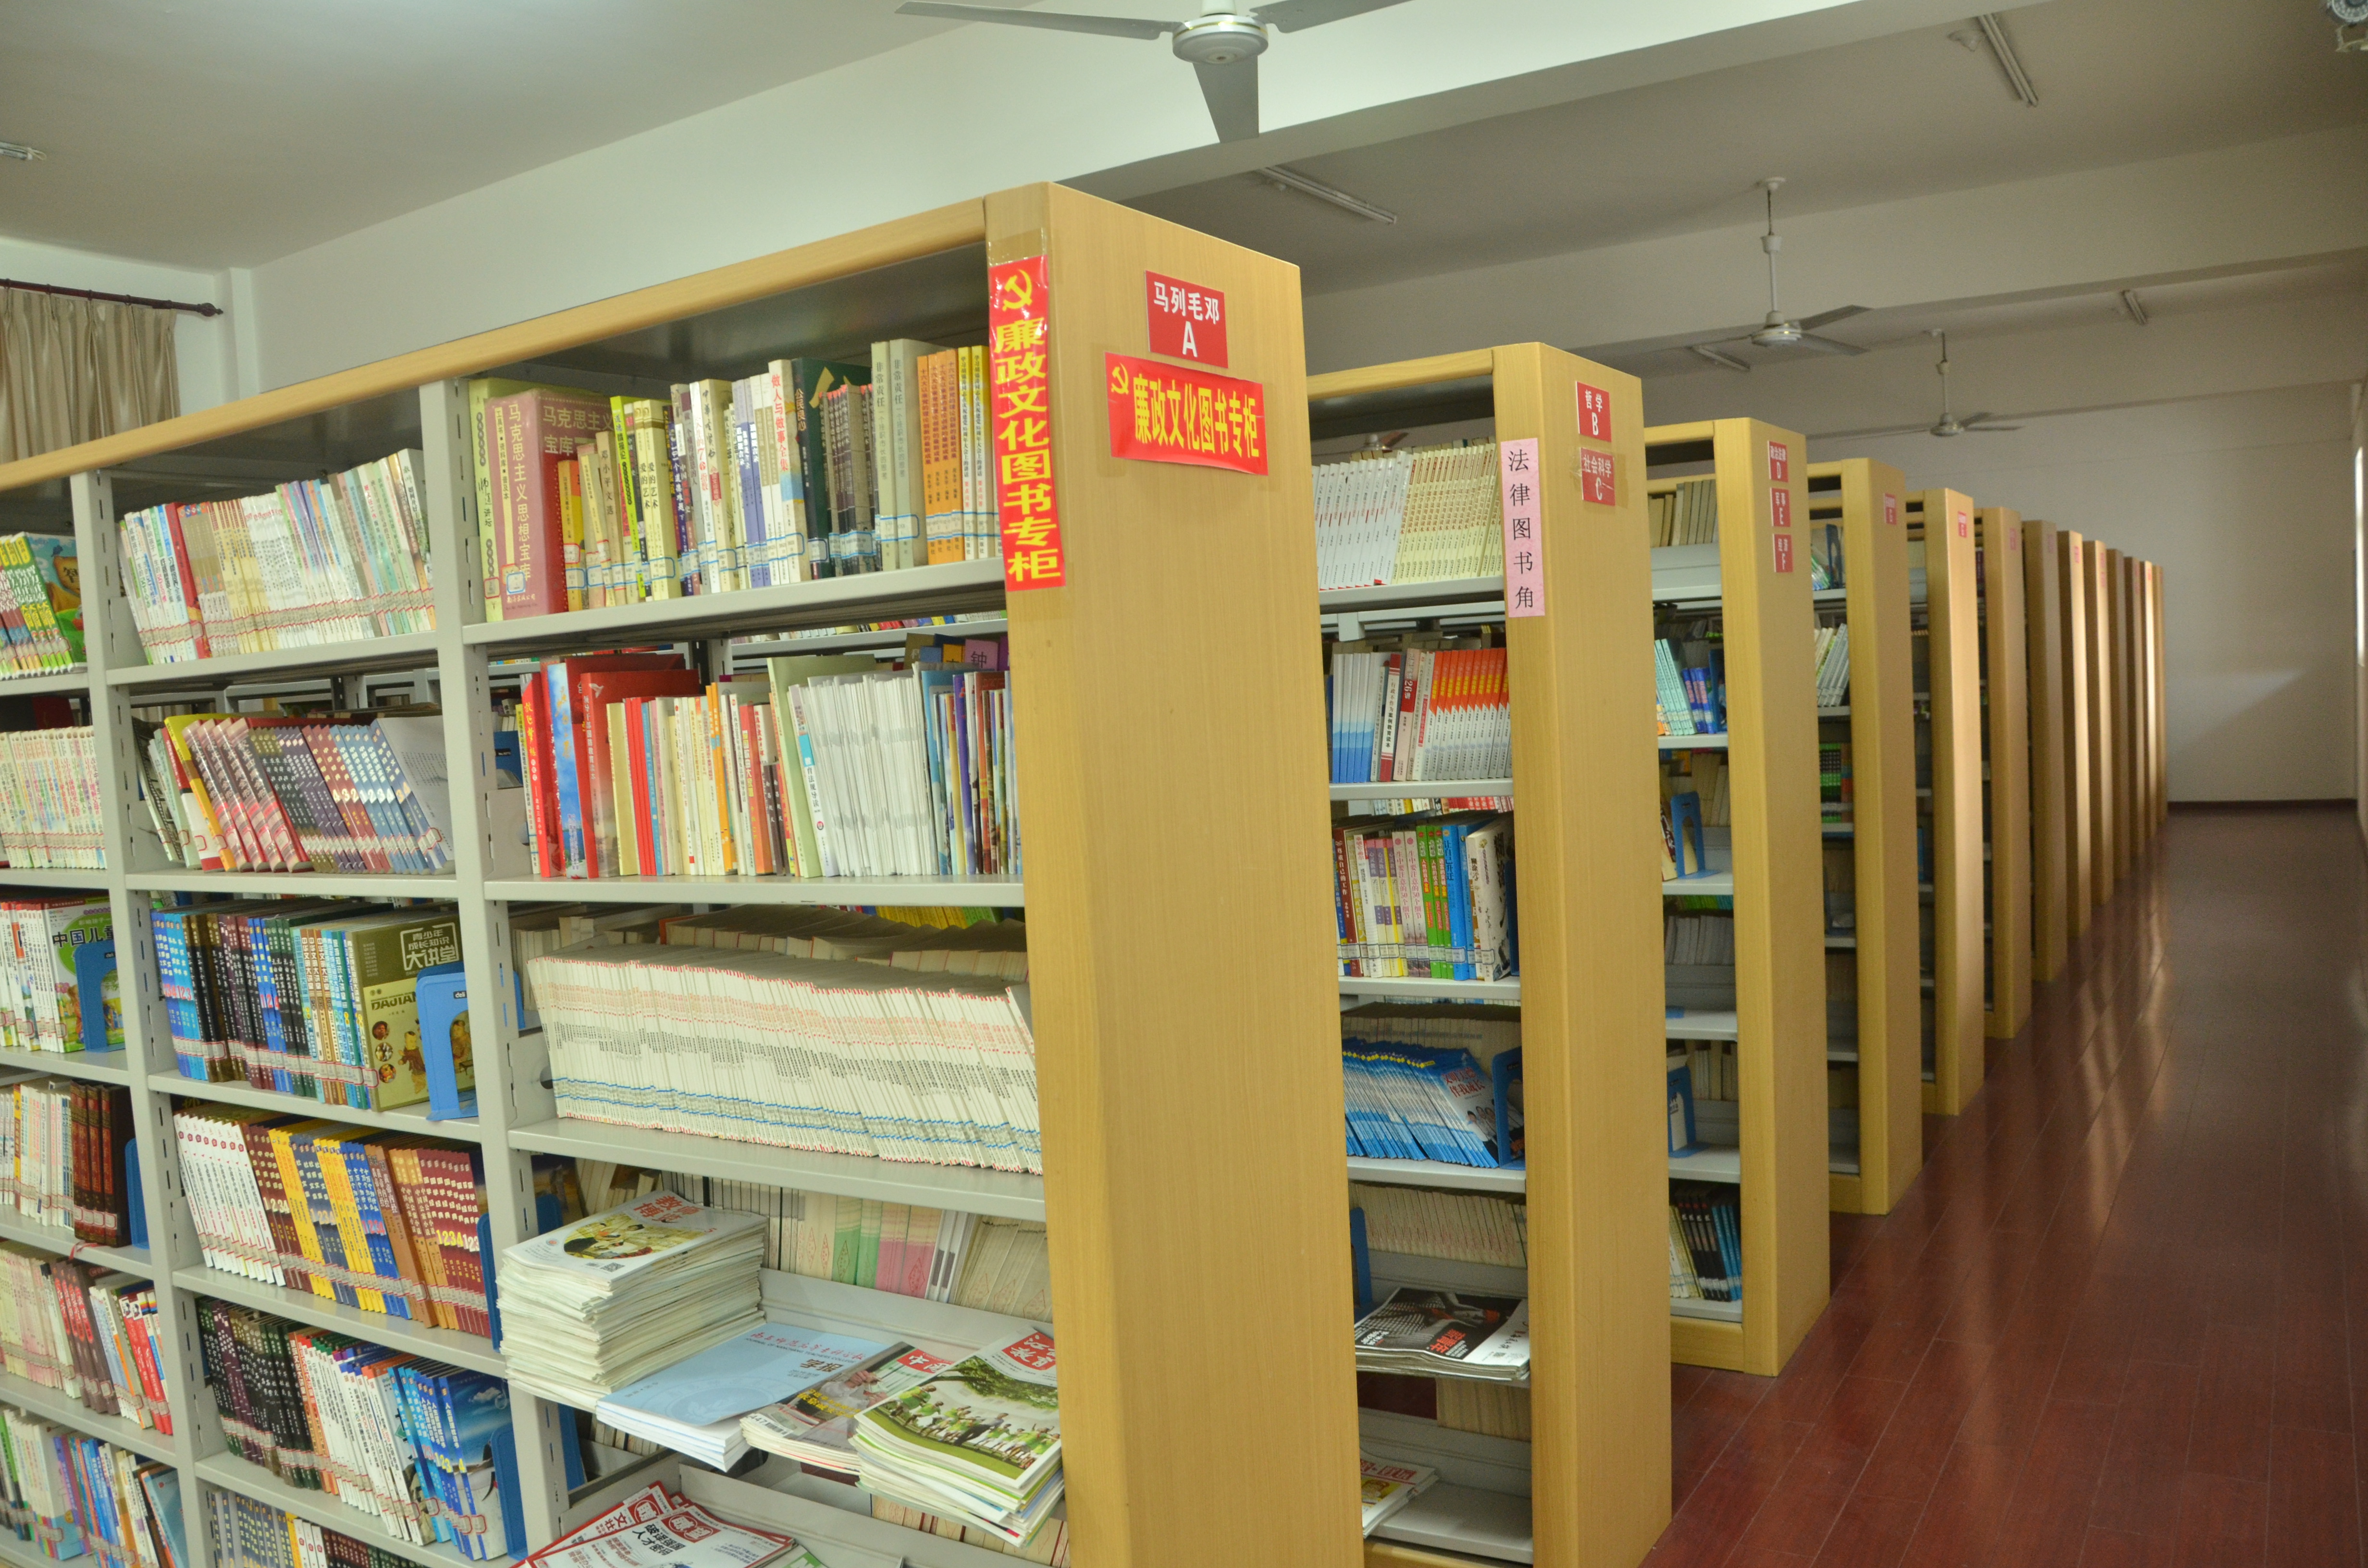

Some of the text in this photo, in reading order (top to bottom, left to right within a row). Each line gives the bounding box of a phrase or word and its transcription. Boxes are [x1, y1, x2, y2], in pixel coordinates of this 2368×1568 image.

[1154, 282, 1220, 325] 马列毛邓
[1182, 321, 1197, 357] A
[876, 361, 886, 407] 非常责任
[893, 359, 902, 404] 非常责任
[1585, 390, 1603, 412] 哲学
[543, 406, 614, 431] 马克思主义
[771, 374, 788, 472] 做人与做事全集
[1133, 373, 1259, 458] 廉政文化图书专柜
[1592, 412, 1599, 435] B
[544, 434, 574, 455] 宝库
[994, 318, 1061, 582] 廉政文化图书专柜
[1583, 454, 1612, 478] 社会科学
[509, 404, 531, 580] 马克思主义思想宝库
[601, 450, 614, 515] 邓小平文选
[640, 463, 650, 509] 爱的艺术
[648, 462, 658, 508] 爱的艺术
[1595, 477, 1603, 501] C
[1508, 449, 1534, 610] 法律图书角
[406, 945, 457, 968] 大讲堂
[408, 936, 449, 951] 成长知识
[413, 929, 443, 941] 青少年
[302, 937, 313, 990] 中华文明大讲堂
[309, 937, 321, 990] 中华文明大讲堂
[317, 938, 329, 990] 中华文明大讲堂
[801, 1359, 843, 1372] 学报
